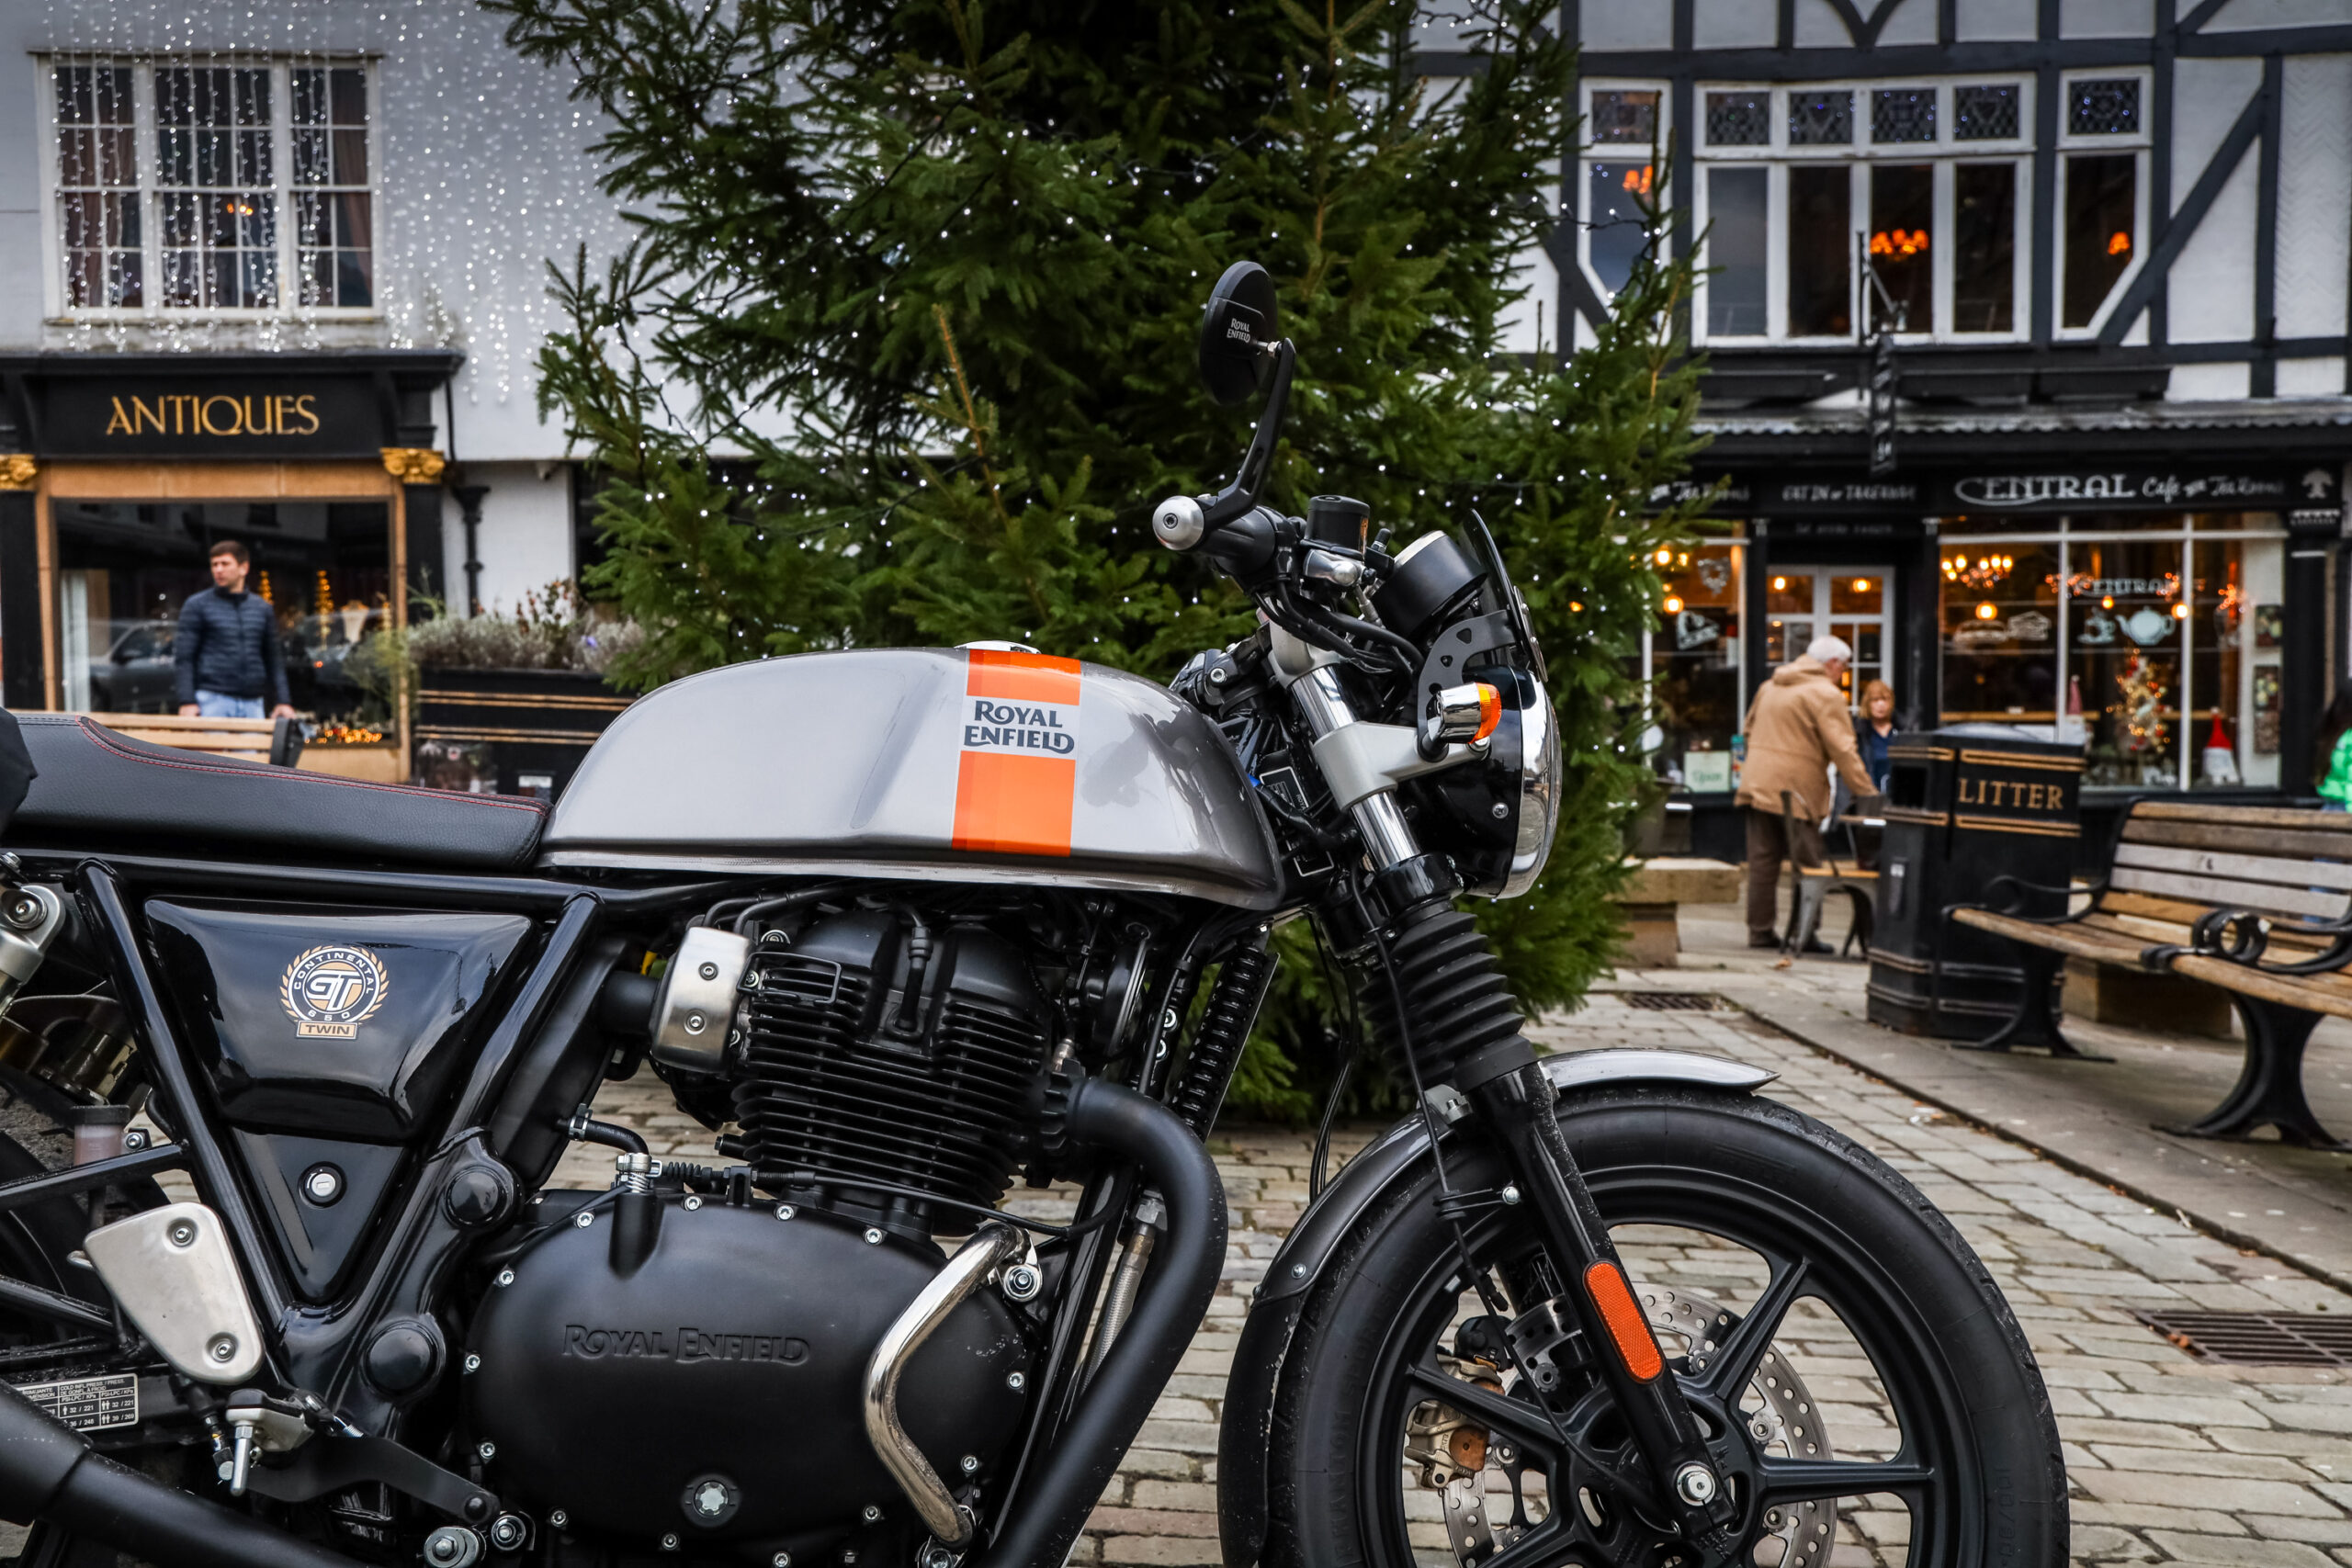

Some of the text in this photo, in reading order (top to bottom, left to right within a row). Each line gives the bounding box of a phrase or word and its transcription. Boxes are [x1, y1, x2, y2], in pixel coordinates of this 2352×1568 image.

[1227, 329, 1250, 344] ENFIELD
[1231, 318, 1250, 333] ROYAL
[106, 395, 321, 436] ANTIQUES
[1954, 474, 2137, 506] CENTRAL
[974, 700, 1063, 728] ROYAL
[964, 725, 1075, 754] ENFIELD
[1958, 777, 2064, 810] LITTER
[294, 952, 375, 994] CONTINENTAL
[306, 969, 363, 1011] GT
[305, 1024, 351, 1034] TWIN
[308, 1010, 351, 1021] 650
[562, 1325, 810, 1367] ROYAL ENFIELD
